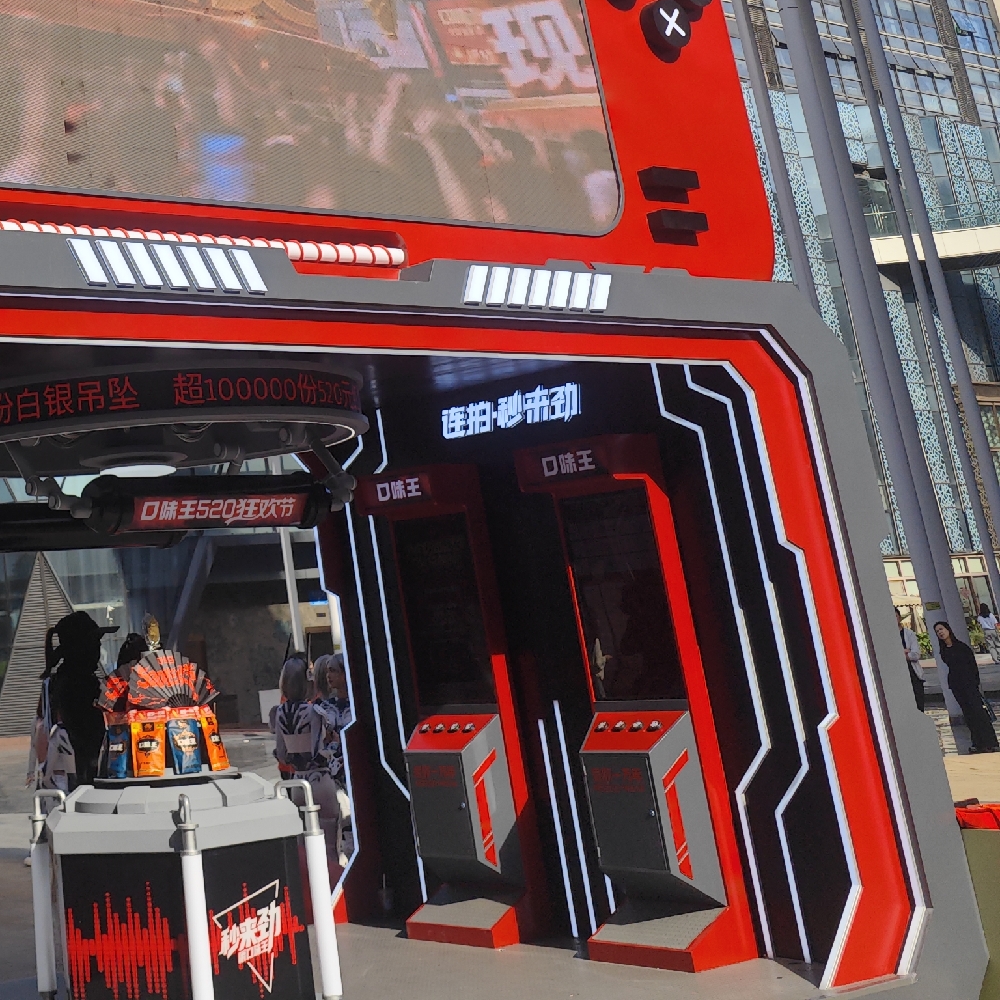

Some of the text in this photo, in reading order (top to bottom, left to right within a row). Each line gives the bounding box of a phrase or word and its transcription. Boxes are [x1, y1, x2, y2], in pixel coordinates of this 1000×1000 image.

[541, 449, 596, 477] 口味王
[376, 477, 422, 501] 口味王
[140, 497, 296, 526] 口味王520狂欢节
[219, 900, 282, 960] 秒来劲
